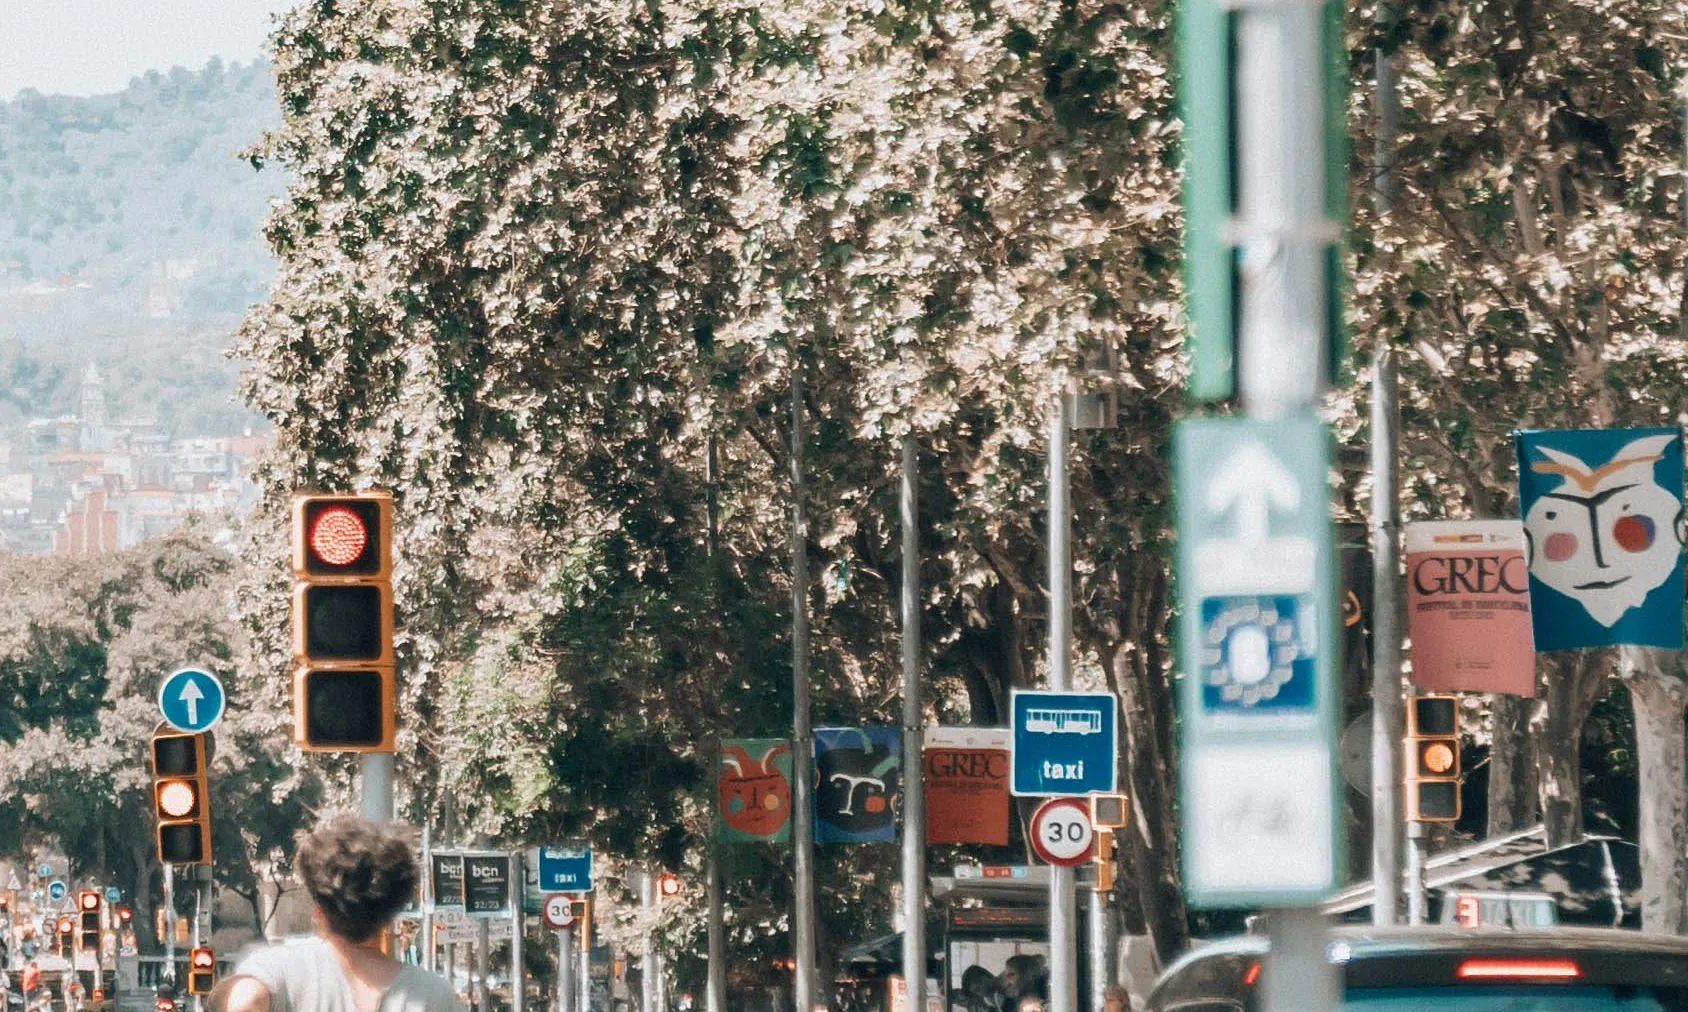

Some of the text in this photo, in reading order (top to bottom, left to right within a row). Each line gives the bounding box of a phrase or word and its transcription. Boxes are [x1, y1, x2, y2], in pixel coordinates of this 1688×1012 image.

[1414, 555, 1529, 596] GREC
[929, 752, 1006, 778] GREC
[1043, 760, 1085, 780] taxi
[1048, 821, 1085, 843] 30
[472, 864, 499, 878] bcn
[551, 904, 571, 917] 30
